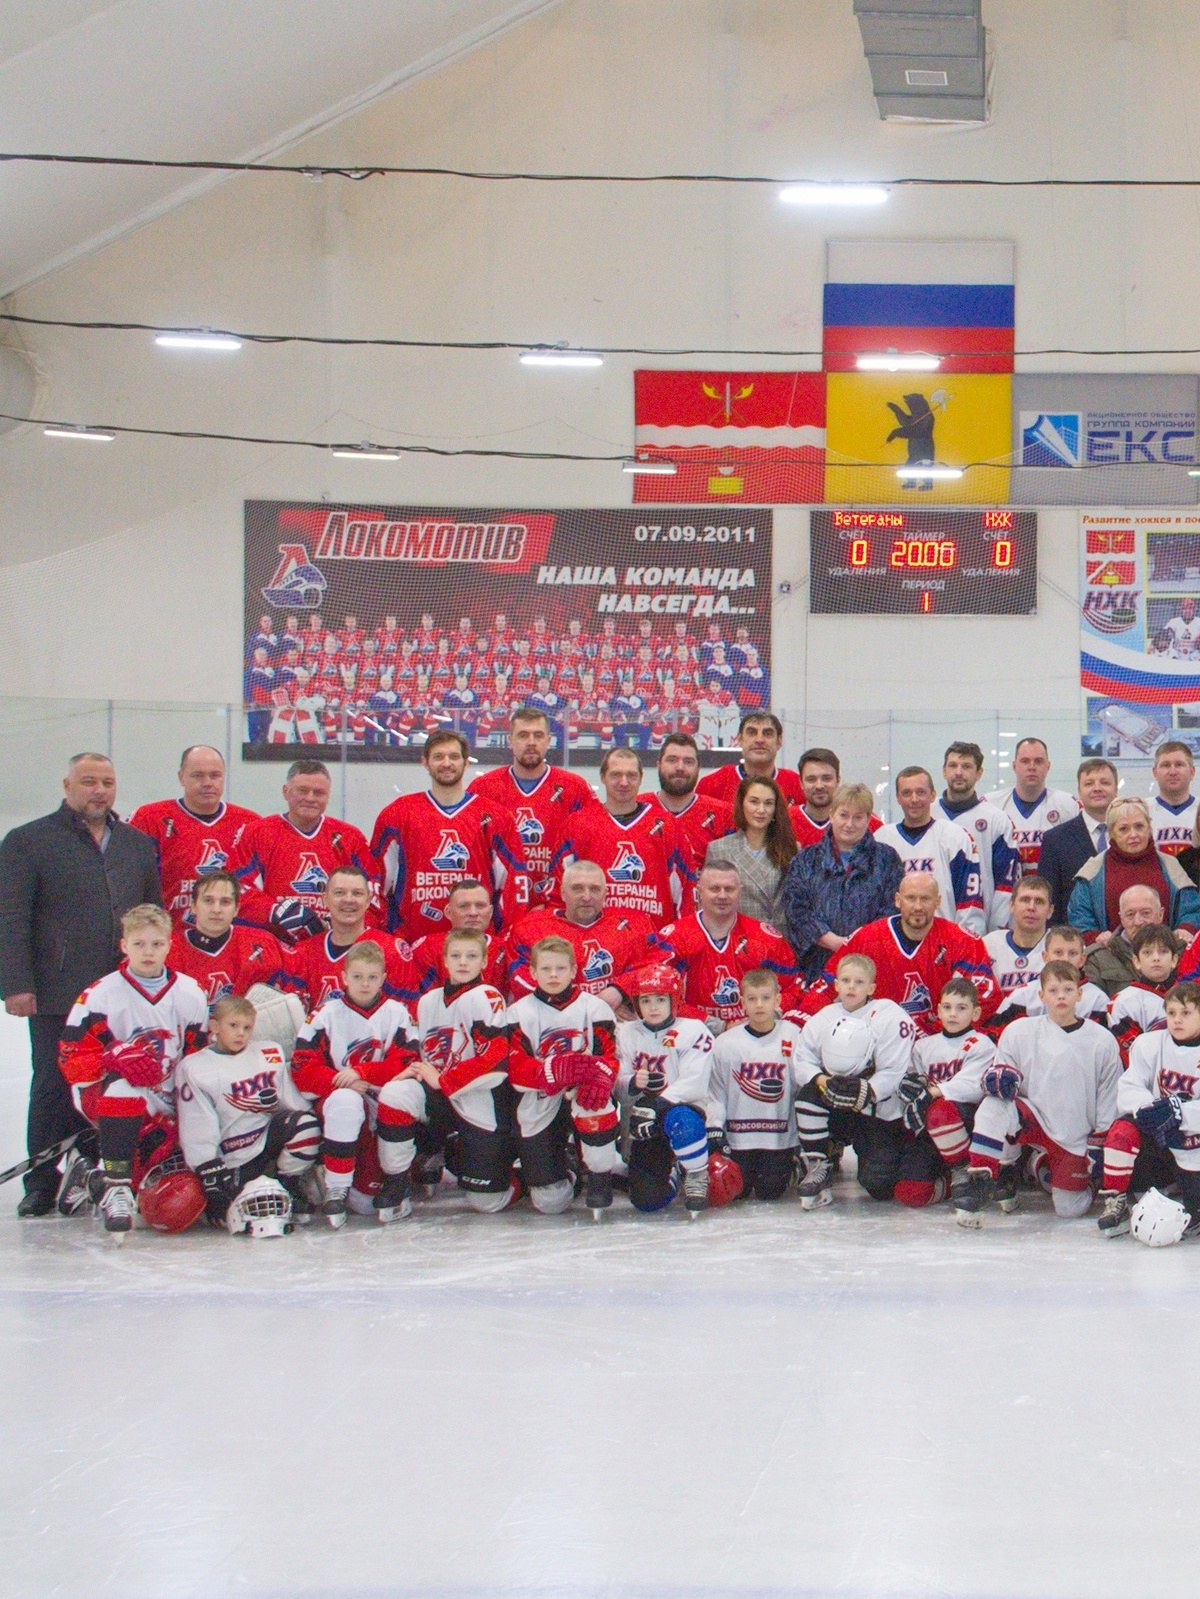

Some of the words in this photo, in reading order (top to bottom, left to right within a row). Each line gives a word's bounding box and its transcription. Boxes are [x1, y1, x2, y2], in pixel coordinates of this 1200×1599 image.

[1135, 419, 1196, 428] КОМПАНИЙ
[1087, 430, 1195, 462] ЕКС
[834, 511, 903, 526] Ветераны
[985, 511, 1012, 527] НХК
[1082, 515, 1132, 524] Развитие
[634, 525, 755, 543] 07.09.2011
[903, 531, 946, 541] ТАЙМЕР
[852, 540, 868, 565] 0
[995, 541, 1011, 566] 0
[537, 566, 617, 585] НАША
[625, 567, 756, 591] КОМАНДА
[828, 568, 887, 577] УДАЛЕНИЯ
[962, 568, 1021, 577] УДАЛЕНИЯ
[902, 580, 946, 591] ПЕРИОД
[598, 594, 756, 618] НАВСЕГДА...
[923, 592, 930, 612] 1
[1083, 590, 1142, 611] НХК
[1013, 830, 1043, 843] ХК
[1157, 828, 1193, 841] НХК
[606, 884, 657, 899] ЕТЕРАНЫ
[740, 1061, 787, 1081] НХК
[230, 1070, 277, 1098] НХК
[462, 1175, 491, 1186] CCM
